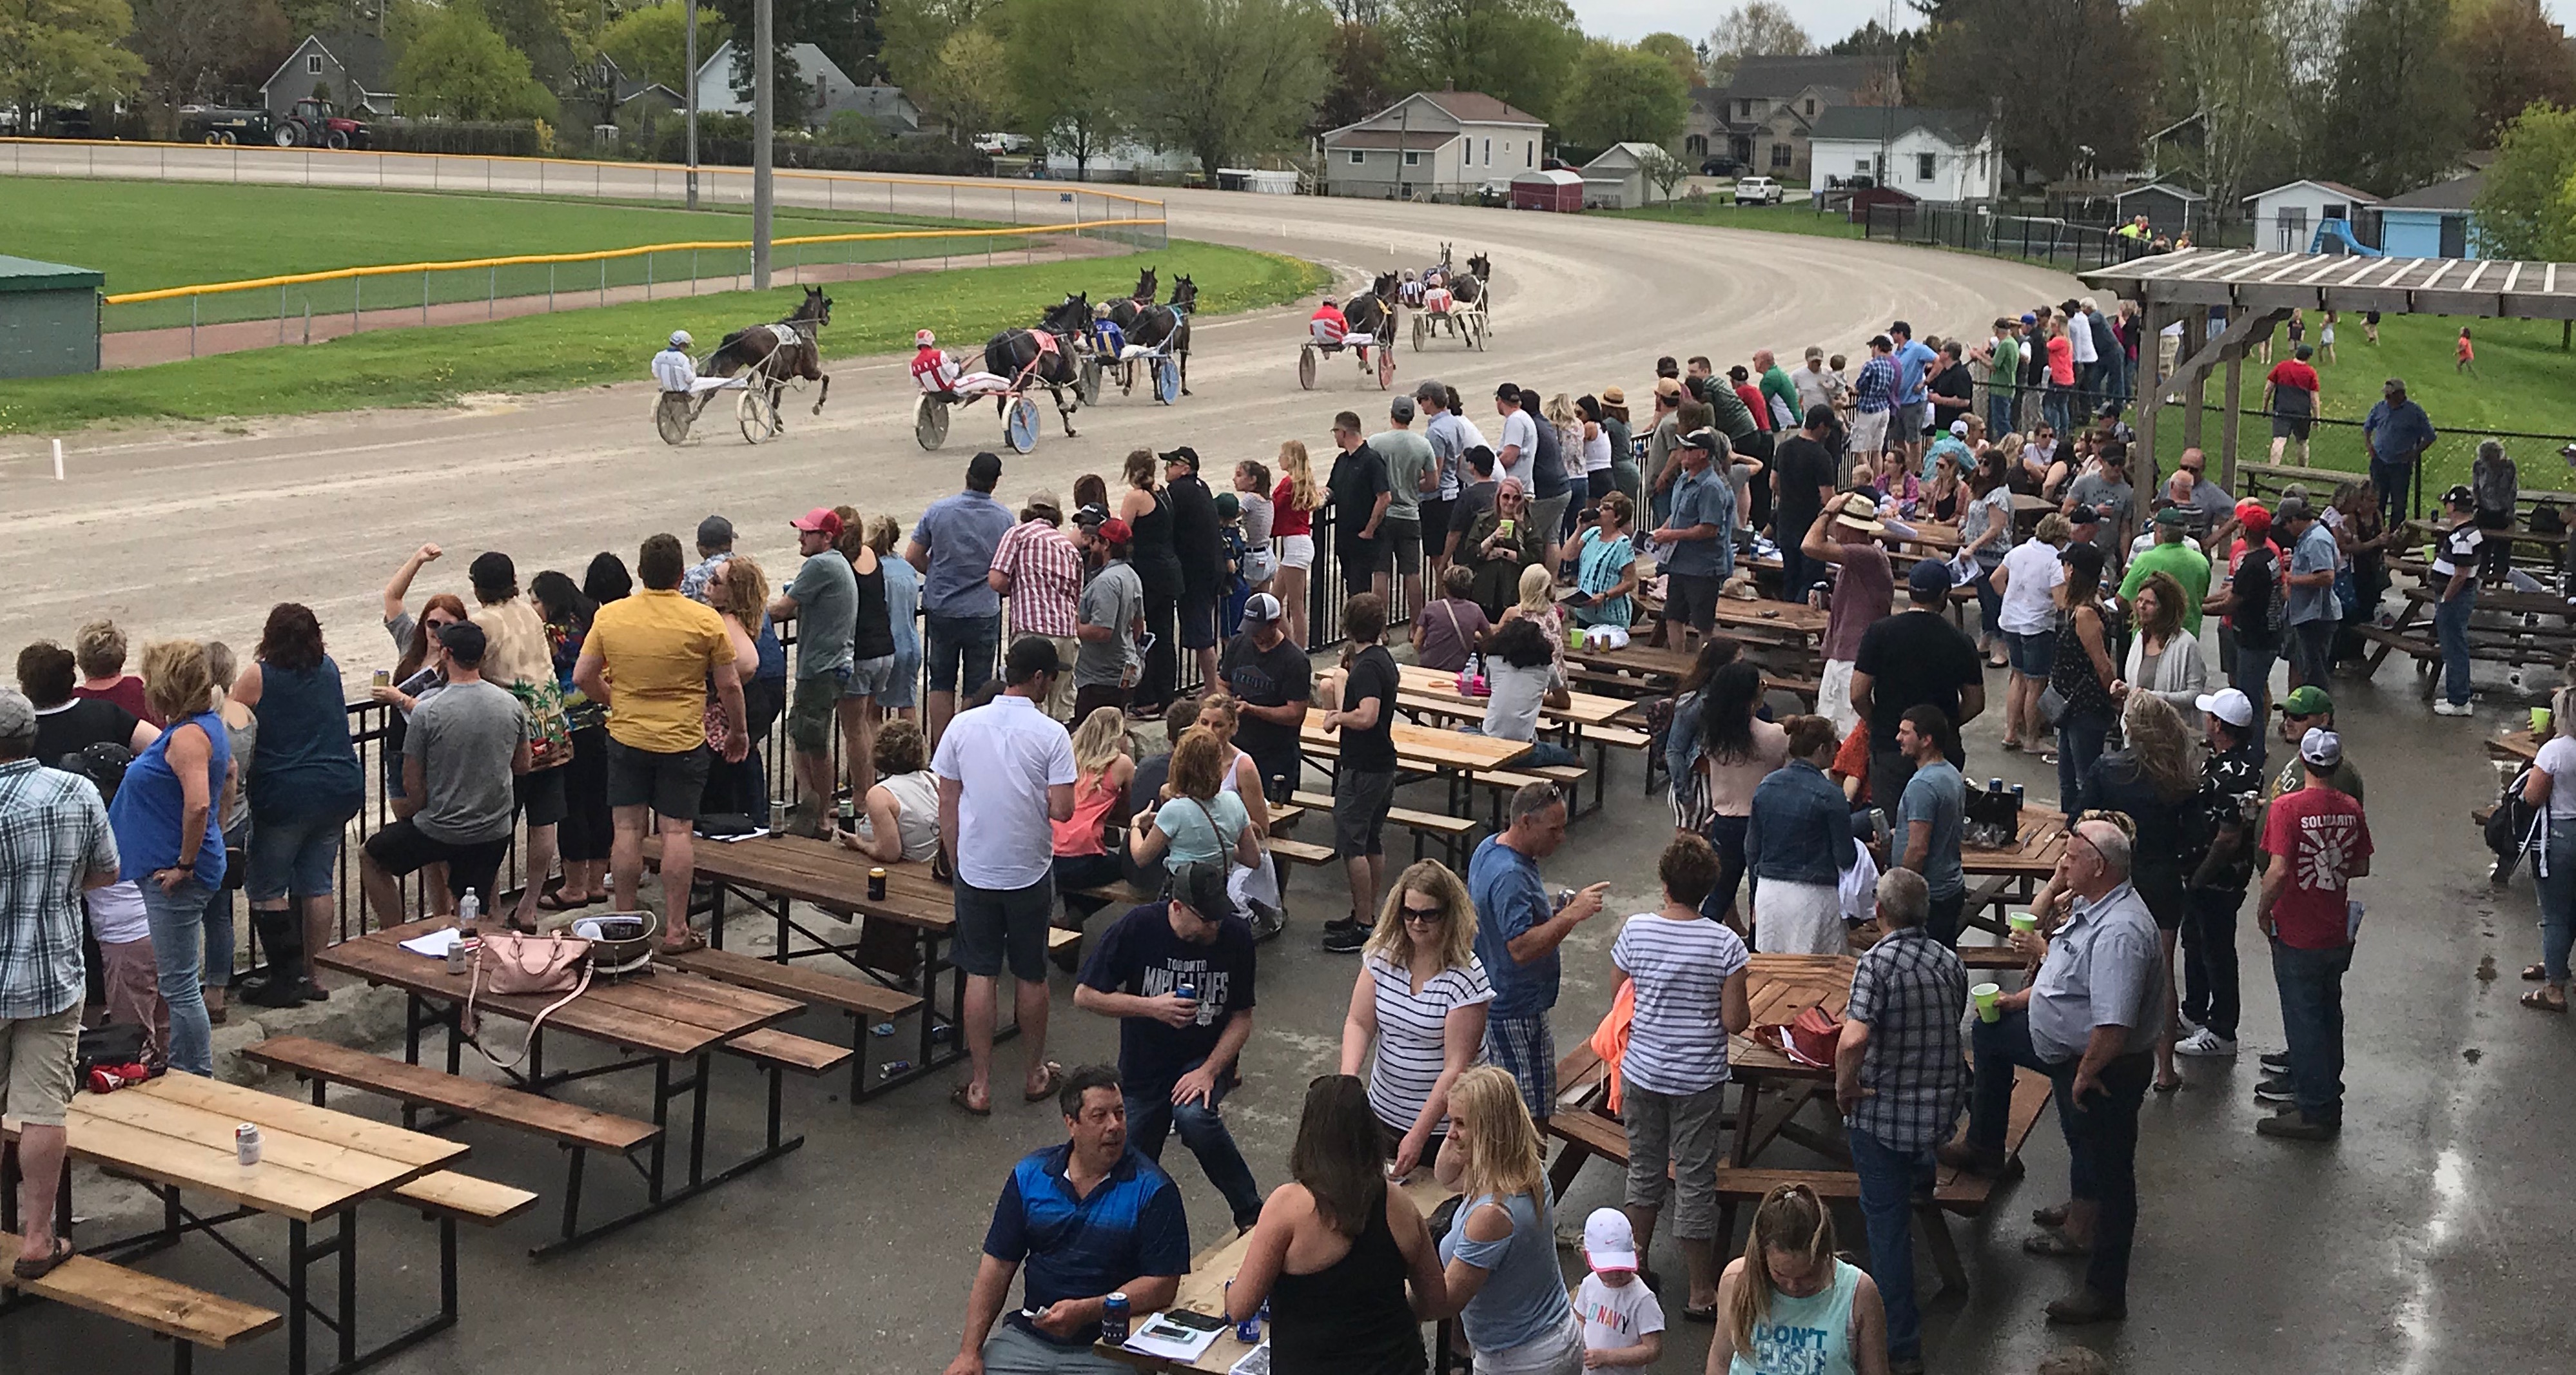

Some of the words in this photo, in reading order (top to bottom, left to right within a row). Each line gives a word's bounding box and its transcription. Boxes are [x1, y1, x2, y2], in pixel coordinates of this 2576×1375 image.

[1167, 957, 1207, 971] TORONTO
[1596, 1304, 1630, 1334] NAVY
[1757, 1322, 1828, 1349] DON'T
